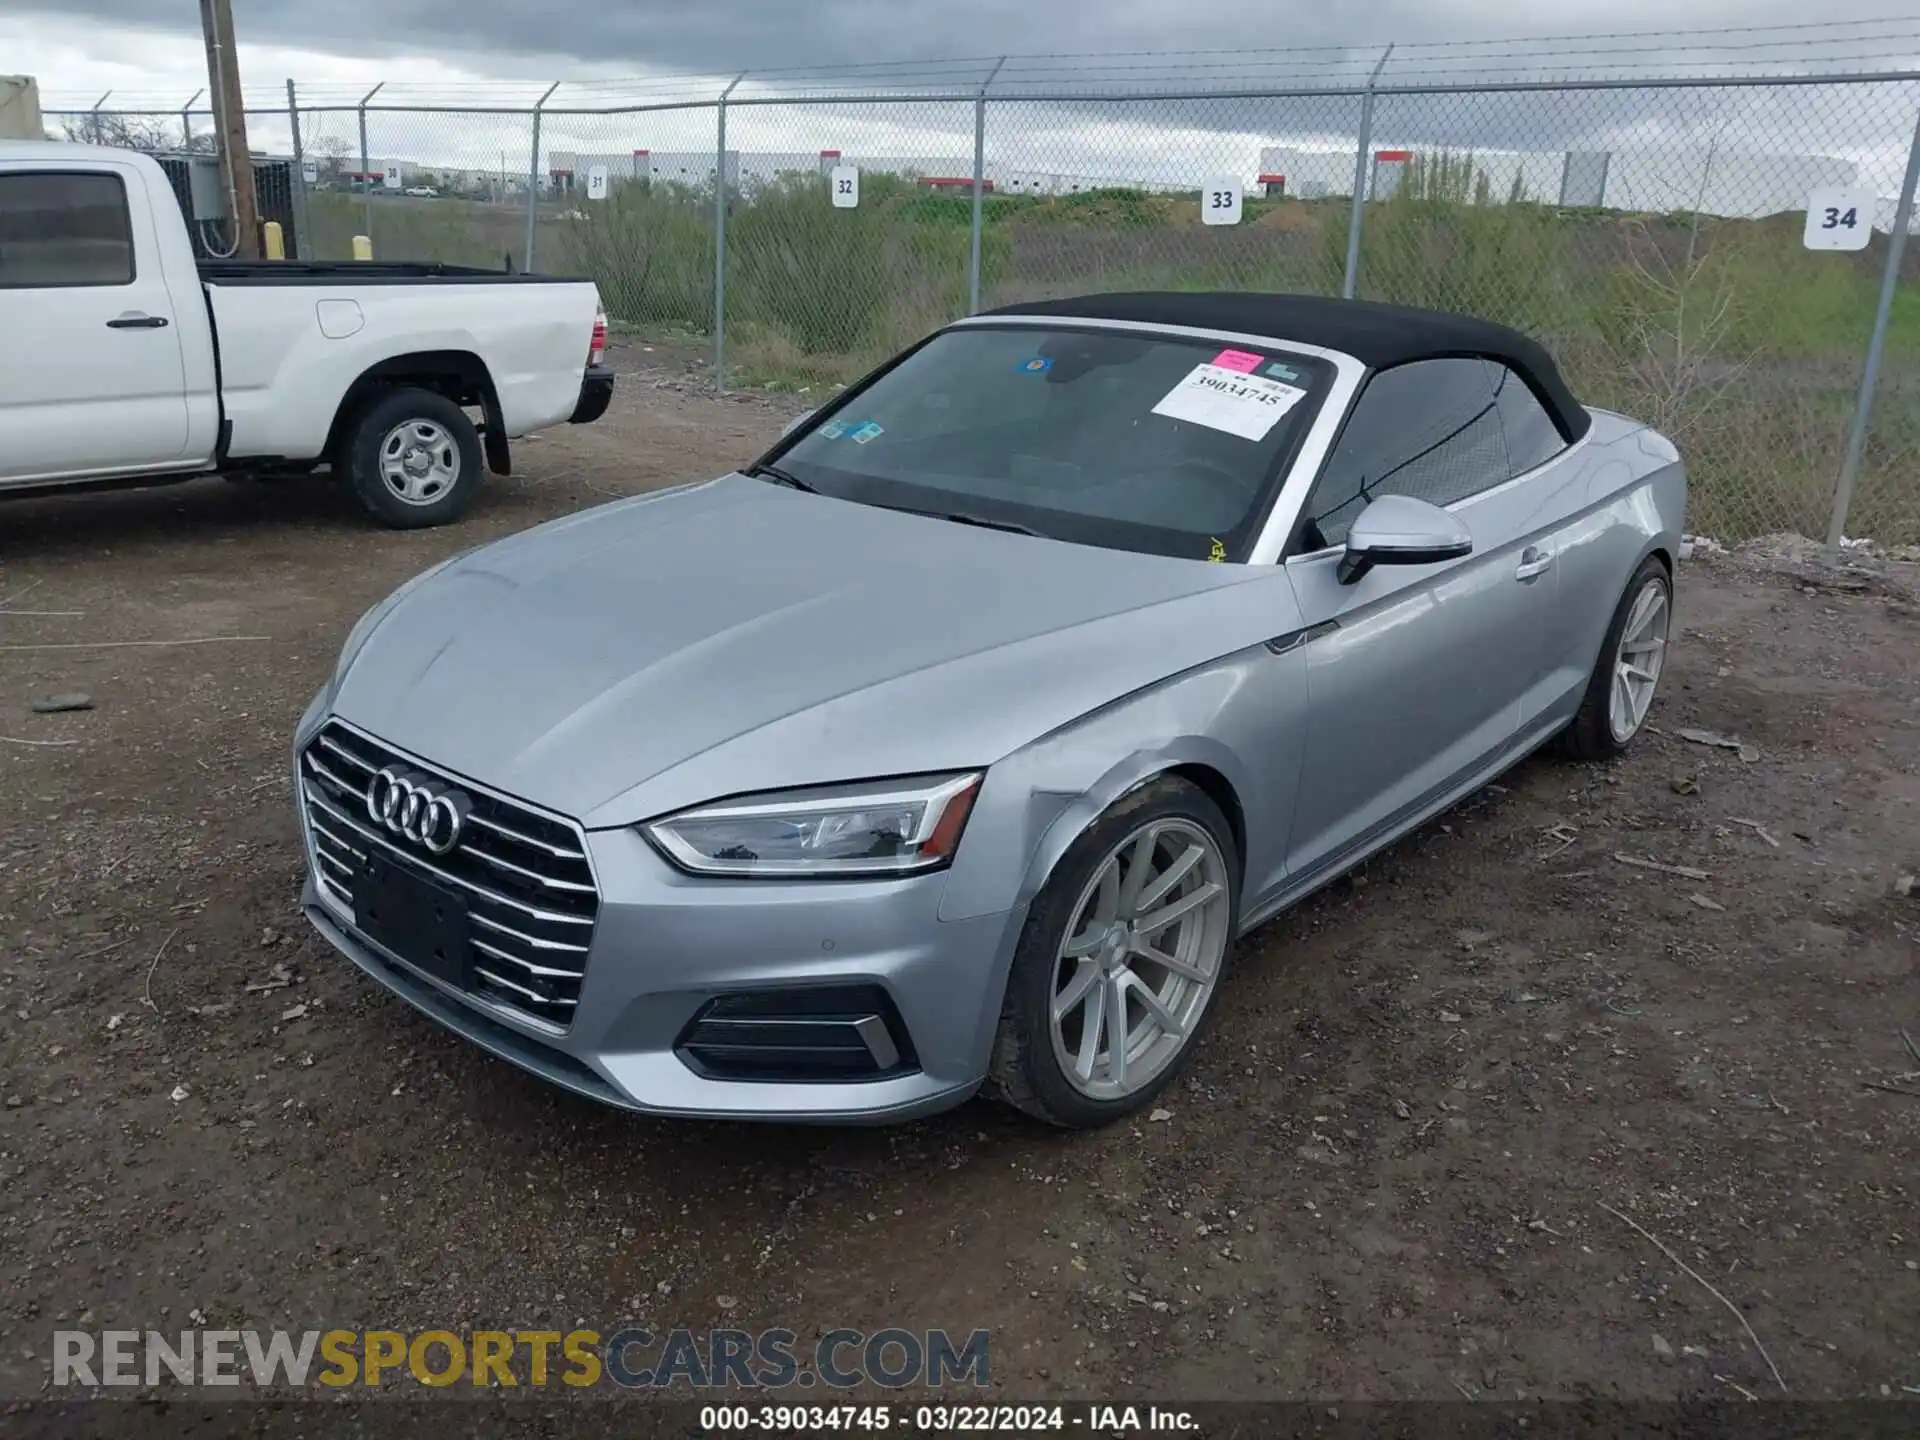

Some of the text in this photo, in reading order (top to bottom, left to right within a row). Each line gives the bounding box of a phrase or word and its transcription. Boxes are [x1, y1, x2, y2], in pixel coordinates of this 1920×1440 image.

[592, 176, 602, 188] 31
[839, 180, 853, 194] 32
[1212, 191, 1233, 209] 33
[1822, 207, 1857, 229] 34
[1193, 376, 1281, 405] 39034745
